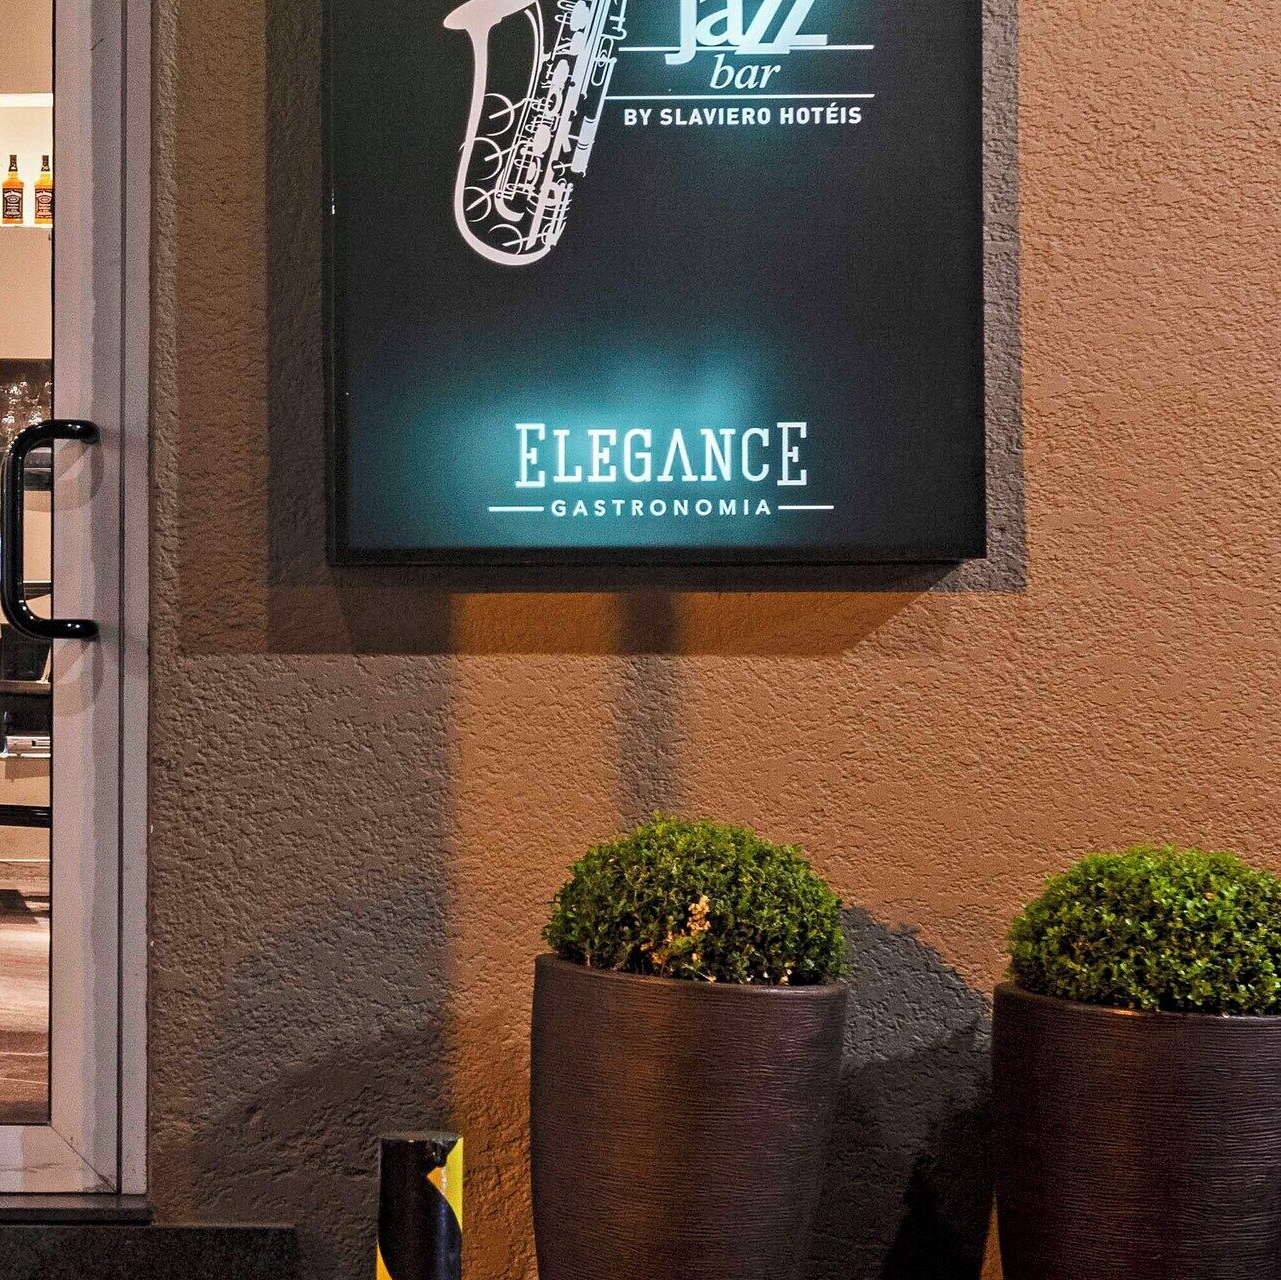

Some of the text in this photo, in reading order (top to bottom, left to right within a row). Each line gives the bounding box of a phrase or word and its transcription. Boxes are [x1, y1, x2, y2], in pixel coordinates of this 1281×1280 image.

[709, 54, 782, 90] bar
[624, 101, 863, 126] BY SLAVIERO HOTÉIS
[515, 422, 808, 488] ELEGANCE
[551, 498, 772, 517] GASTRONOMIA
